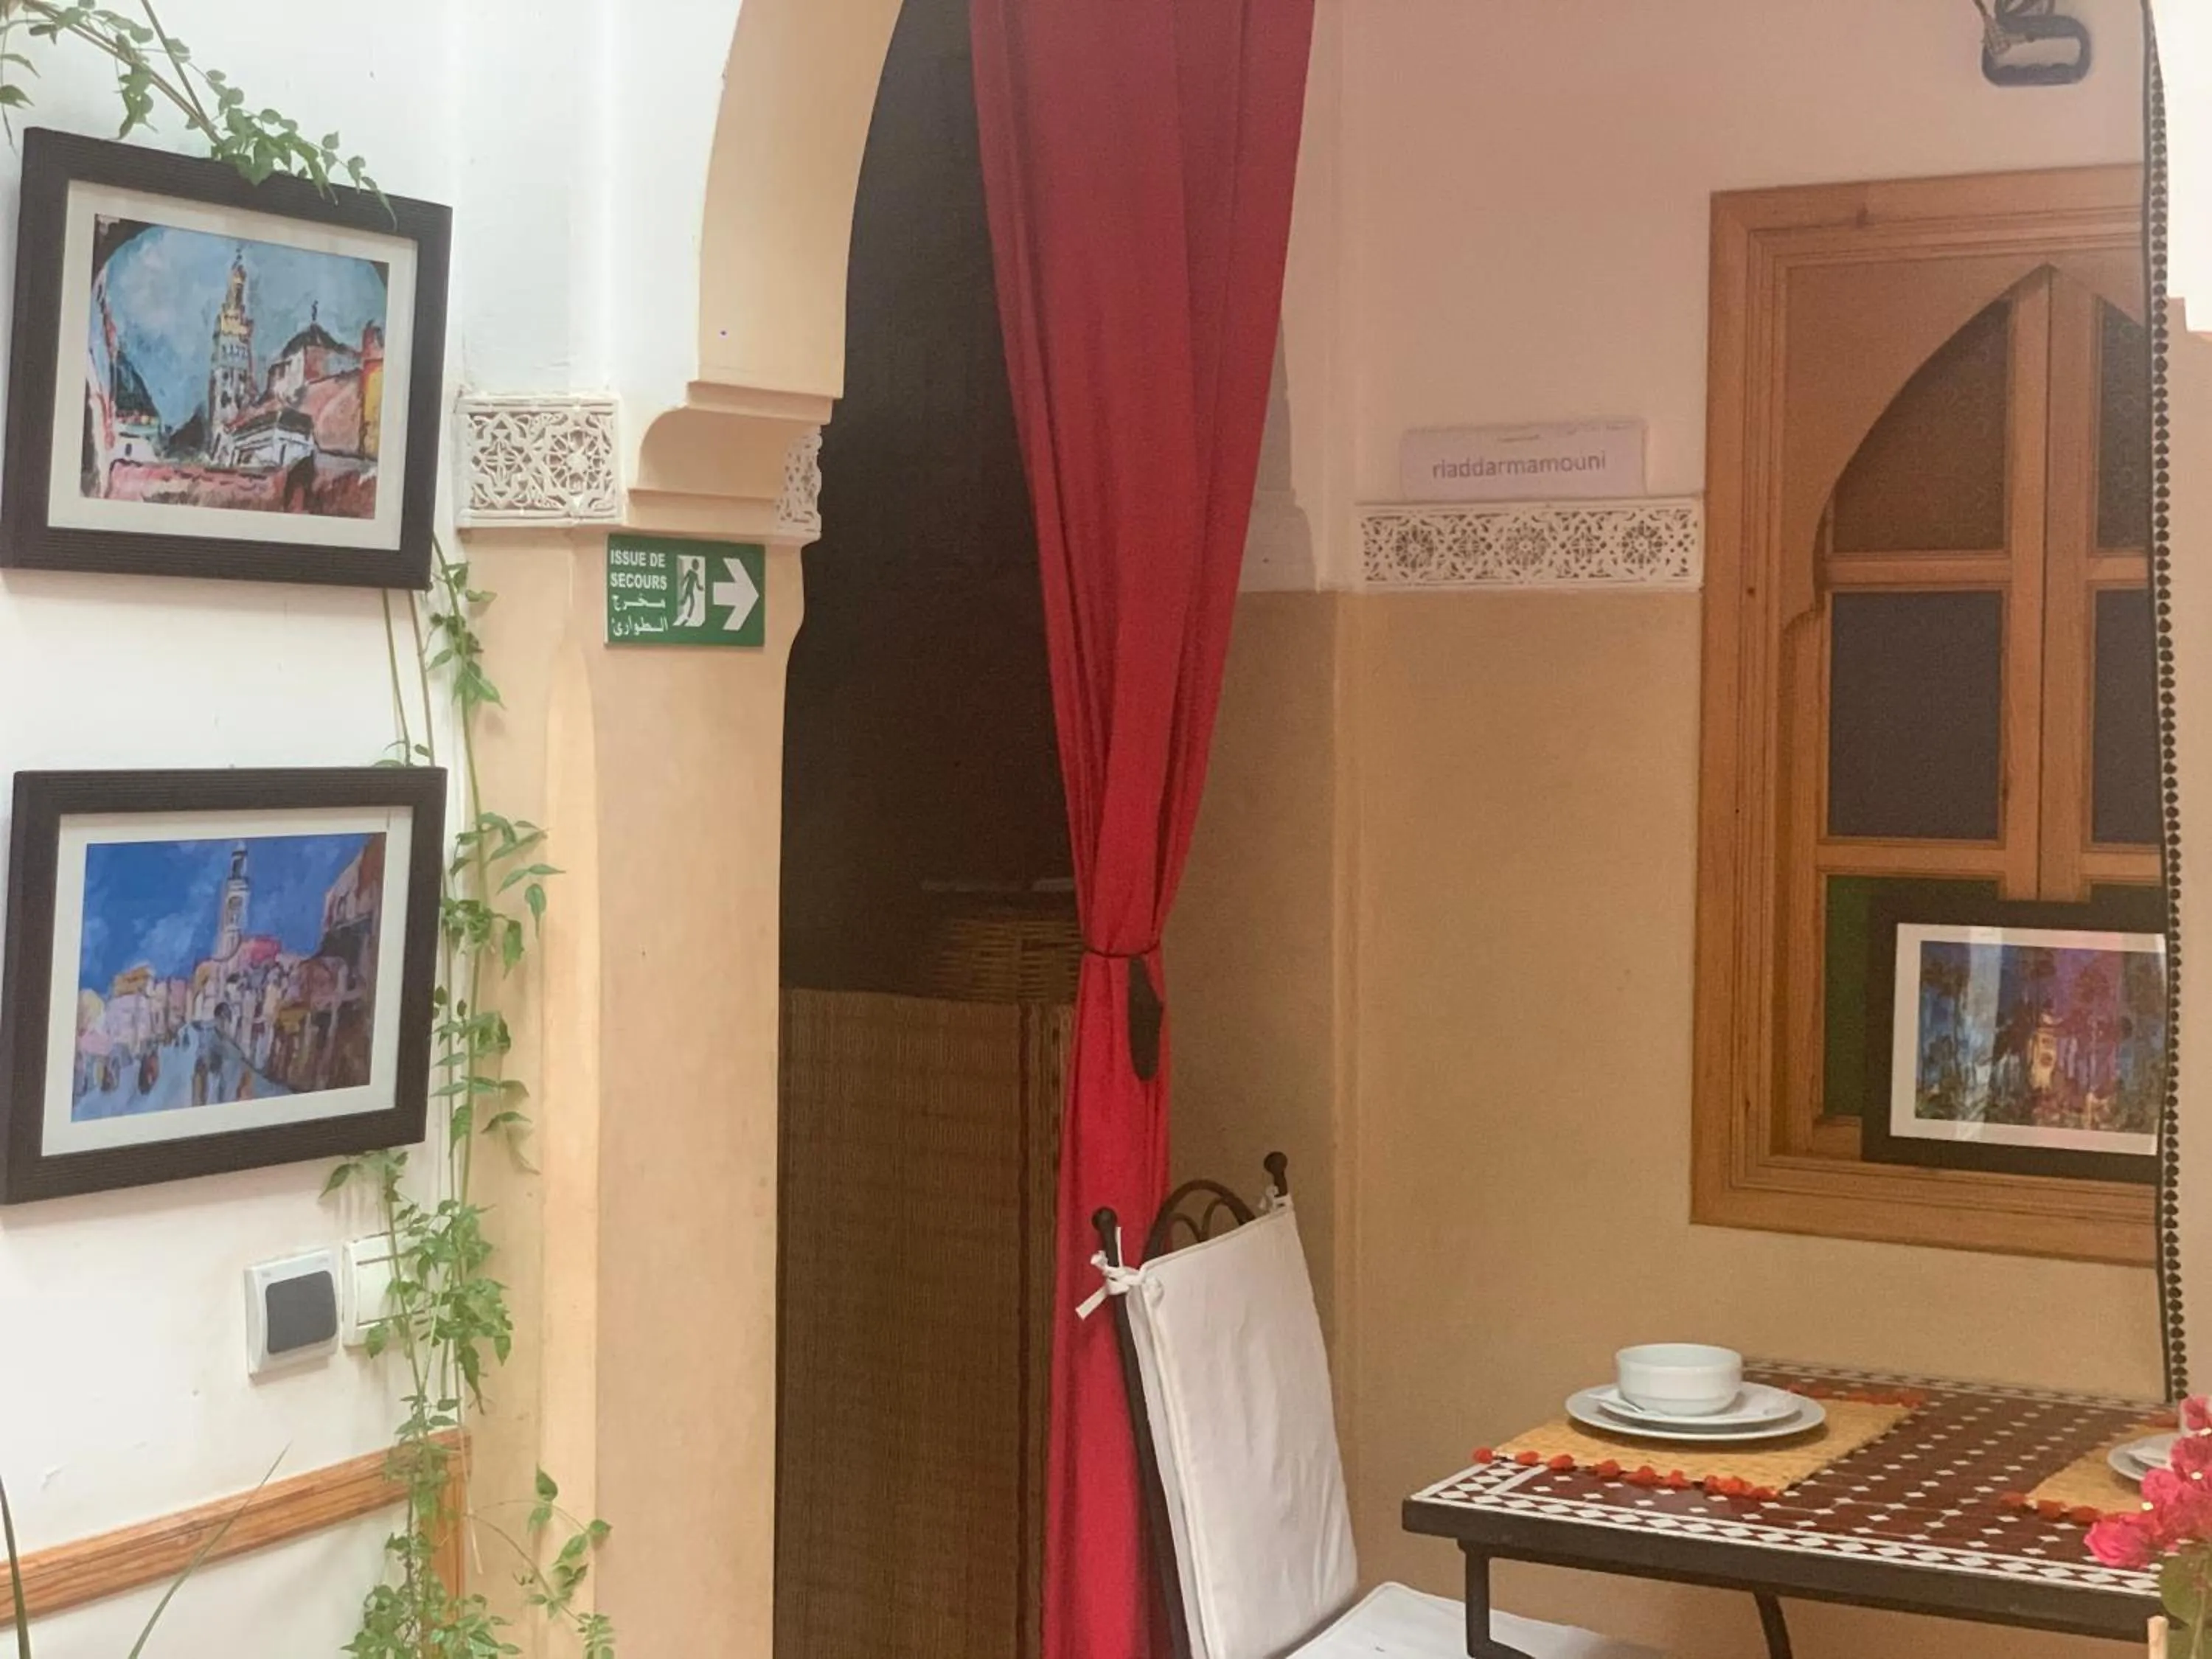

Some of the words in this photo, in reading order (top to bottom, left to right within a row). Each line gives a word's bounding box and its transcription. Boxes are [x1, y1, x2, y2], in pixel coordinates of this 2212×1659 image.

[1432, 450, 1606, 479] riaddarmamouni
[611, 549, 646, 566] ISSUE
[650, 553, 666, 568] DE
[611, 573, 667, 590] SECOURS
